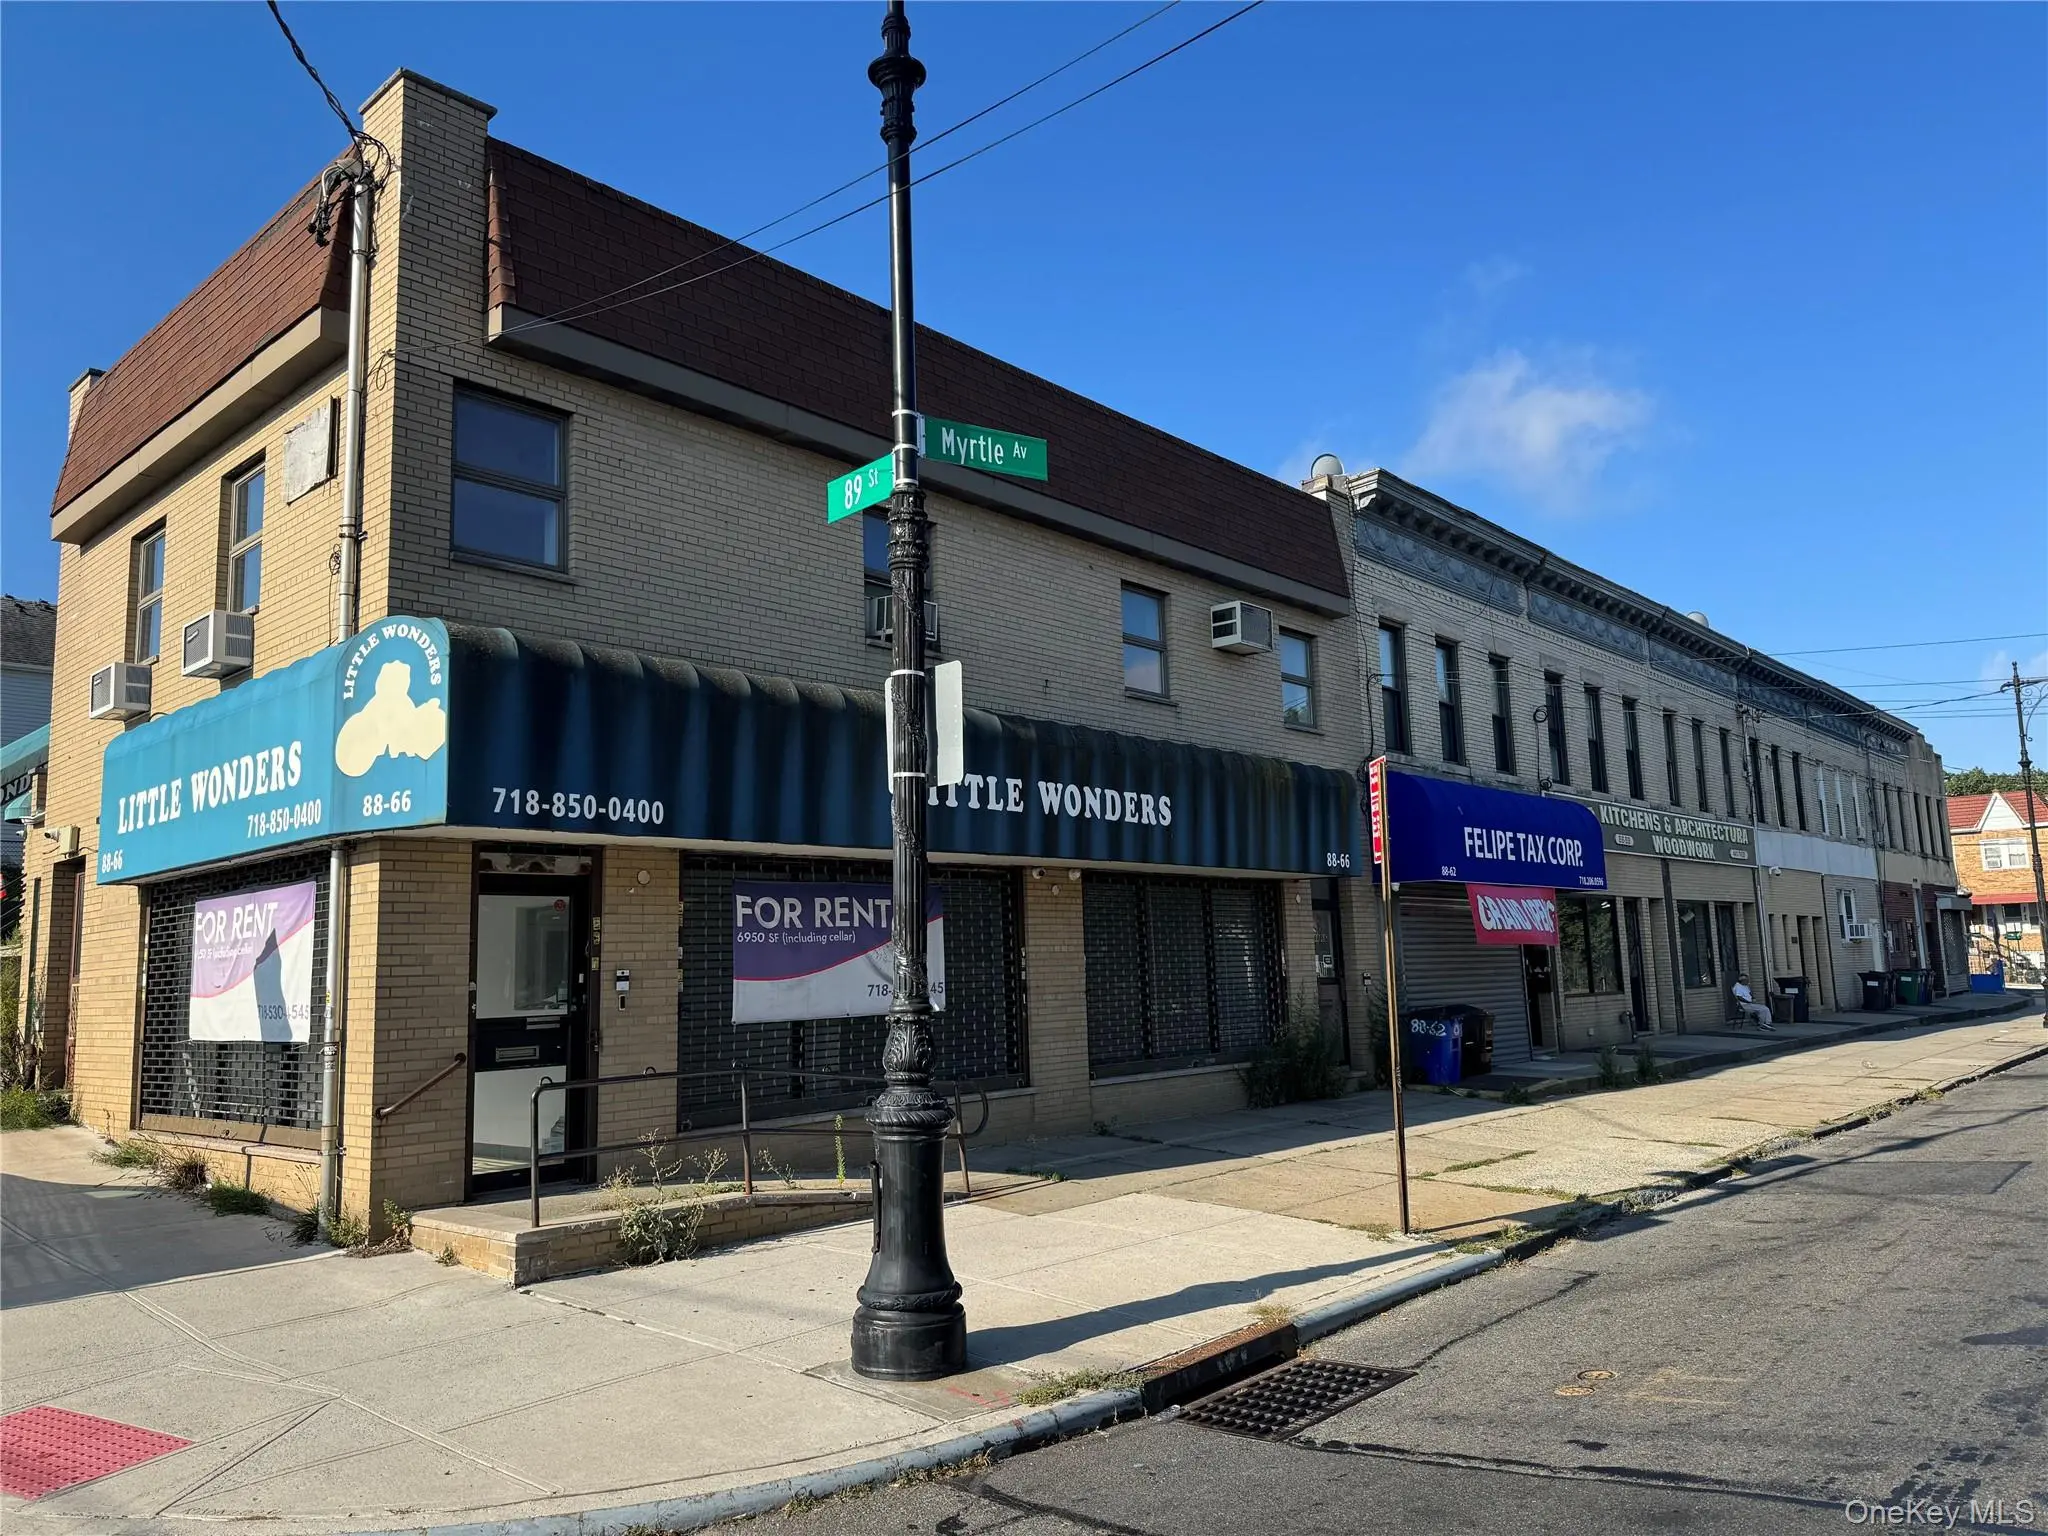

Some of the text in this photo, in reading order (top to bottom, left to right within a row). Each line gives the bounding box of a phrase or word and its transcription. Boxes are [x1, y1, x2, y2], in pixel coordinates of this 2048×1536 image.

[941, 427, 1027, 465] Myrtle Av
[844, 467, 879, 510] 89 St
[343, 623, 442, 700] LITTLE WONDERS
[117, 740, 302, 835] LITTLE WONDERS
[362, 790, 412, 817] 88-66
[492, 786, 665, 825] 718-850-0400
[1037, 780, 1172, 827] WONDERS
[247, 798, 322, 839] 718-850-0400
[1599, 804, 1662, 833] KITCHENS
[1664, 817, 1672, 834] &
[101, 849, 123, 874] 88-66
[1326, 852, 1350, 869] 88-66
[1464, 826, 1584, 867] FELIPE TAX CORP.
[1652, 835, 1716, 860] WOODWORK
[1441, 865, 1457, 877] 88-62
[195, 902, 279, 945] FOR RENT
[735, 894, 892, 929] FOR RENT
[1476, 894, 1532, 931] GRAND
[736, 930, 857, 945] 6950 SF (including cellar)
